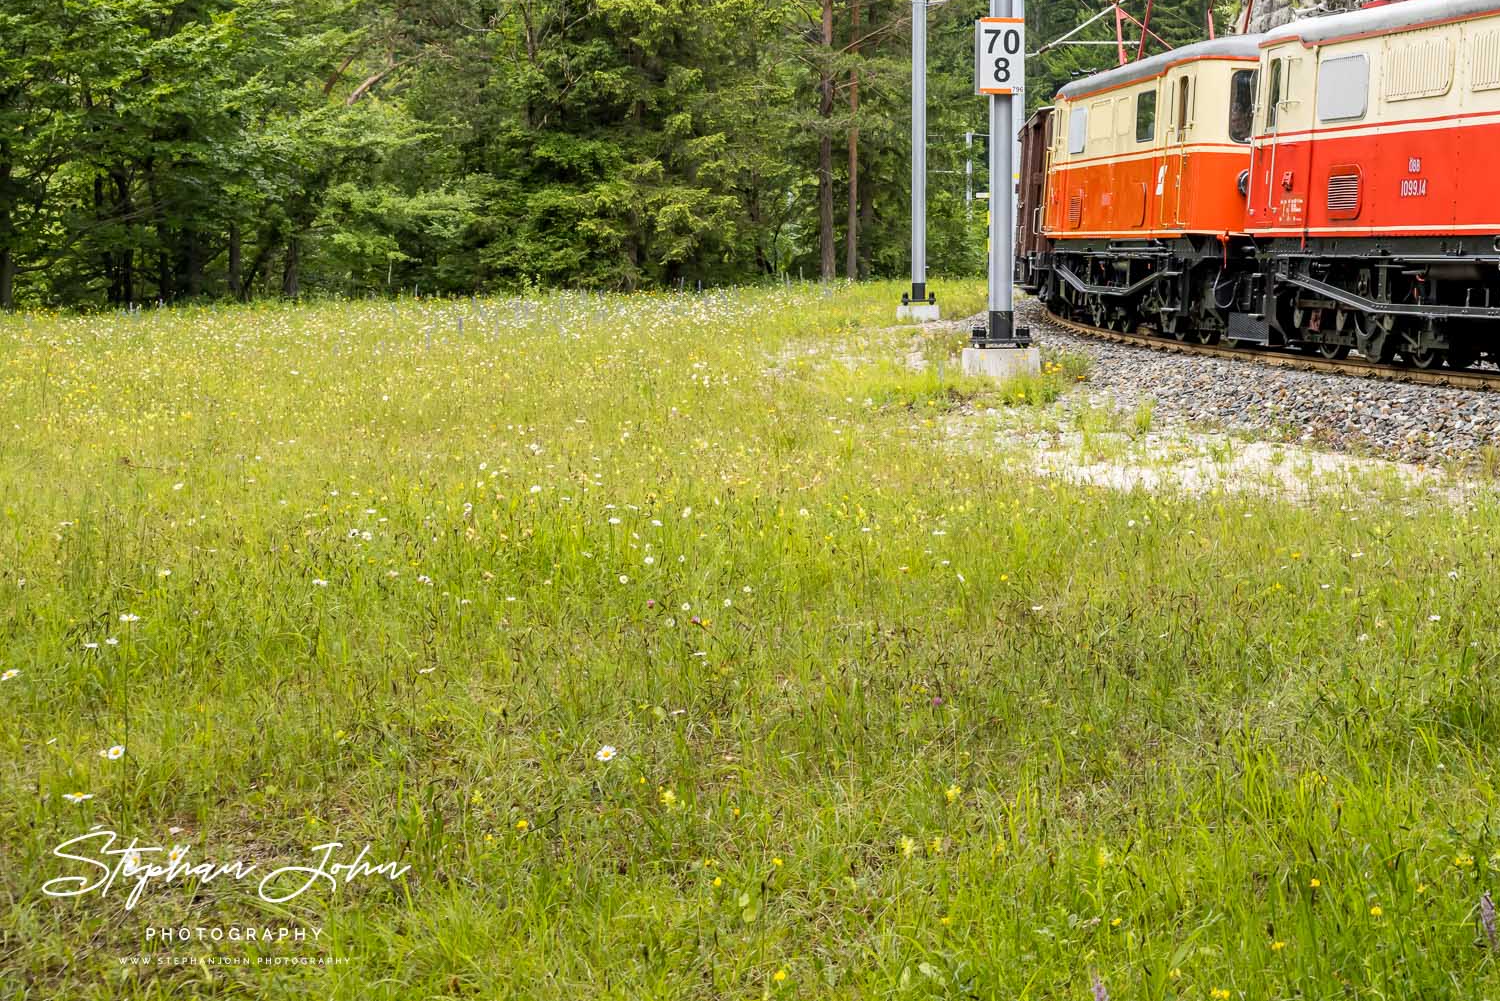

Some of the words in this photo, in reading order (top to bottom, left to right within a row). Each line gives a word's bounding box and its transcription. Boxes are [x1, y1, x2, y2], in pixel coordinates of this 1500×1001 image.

[984, 29, 1020, 54] 70
[994, 57, 1010, 82] 8
[1401, 179, 1426, 197] 1099.14
